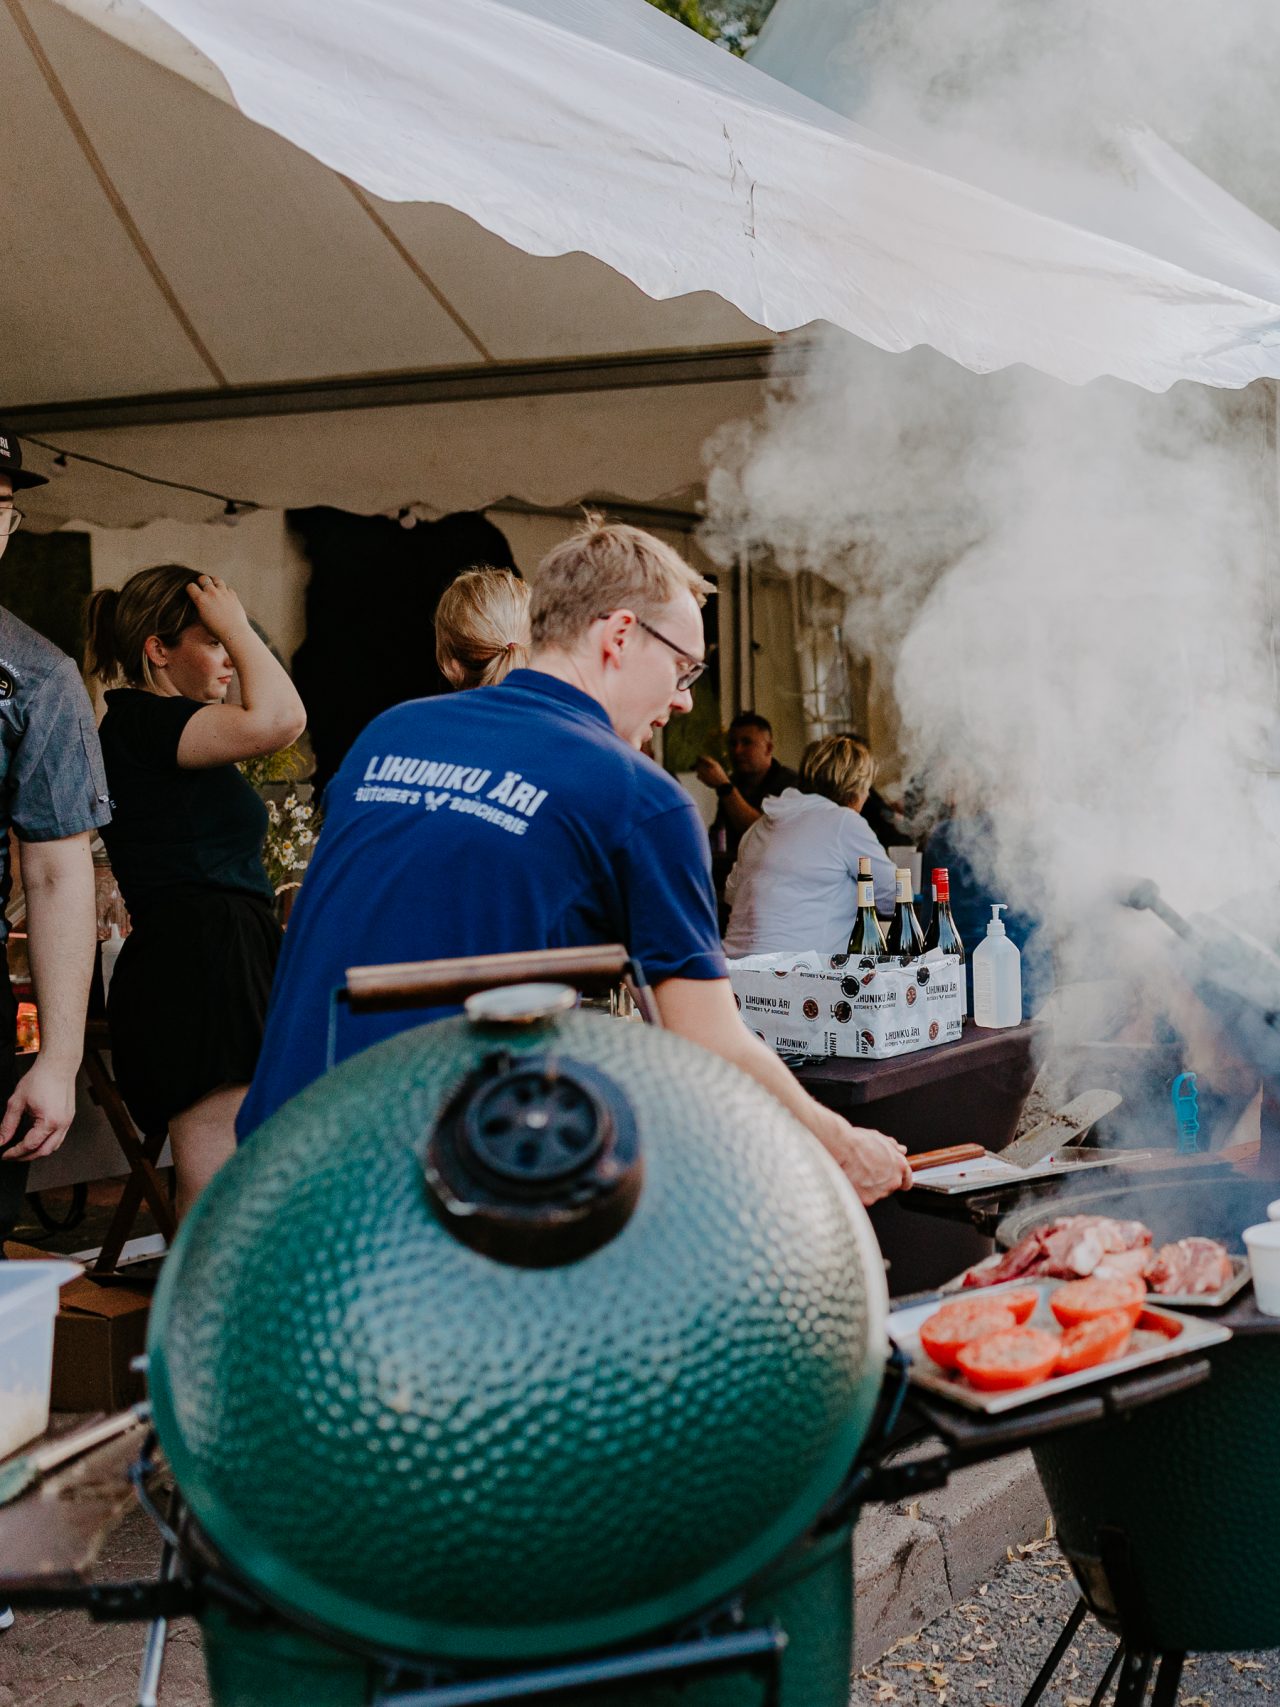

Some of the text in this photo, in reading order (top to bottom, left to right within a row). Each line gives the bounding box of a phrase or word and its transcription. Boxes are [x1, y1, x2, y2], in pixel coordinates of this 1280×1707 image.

[363, 754, 549, 817] LIHUNIKU ÄRI
[449, 796, 530, 836] BOUCHERIE
[745, 994, 791, 1010] LIHUNIKU ÄRI
